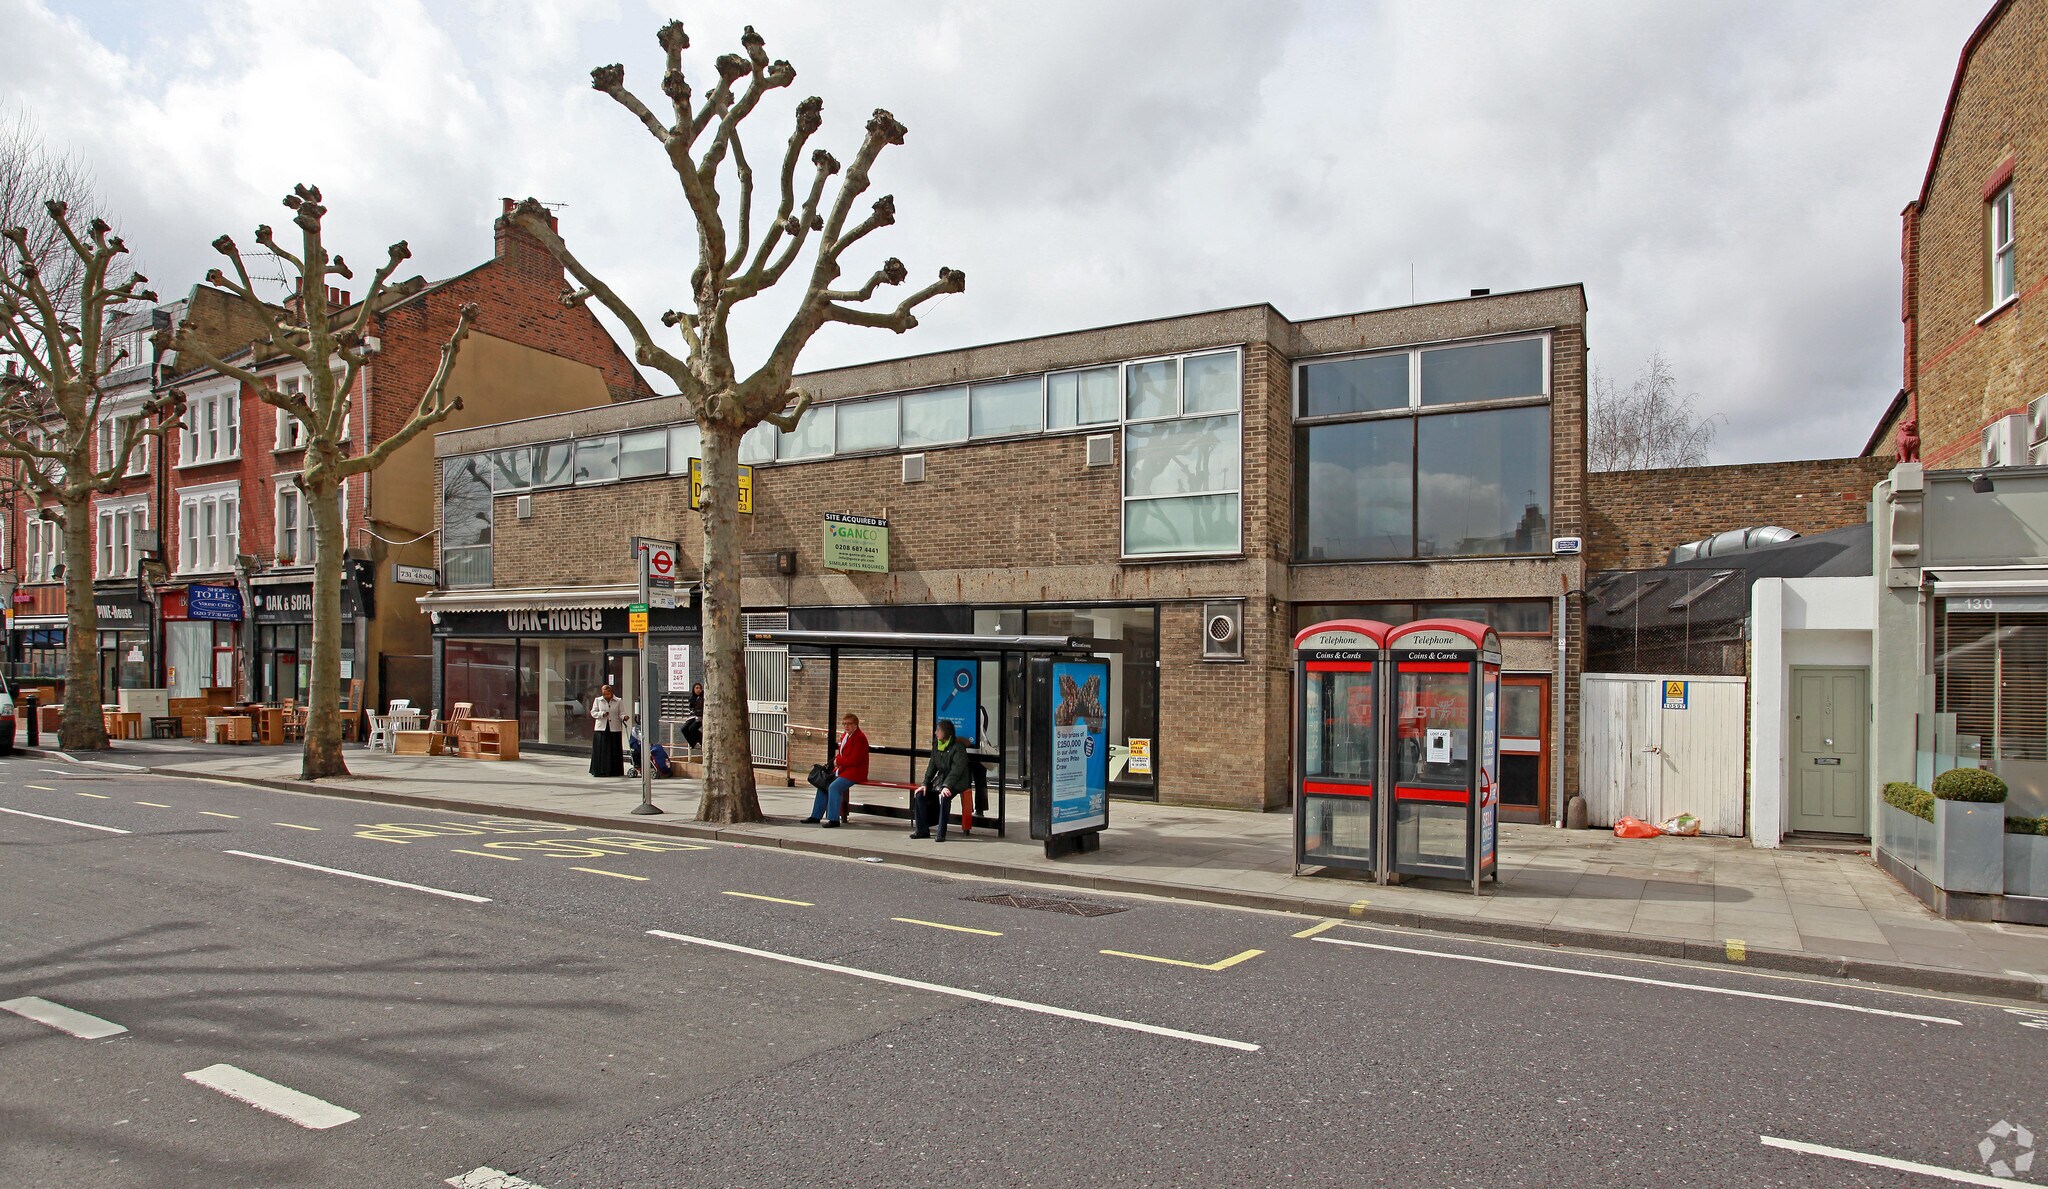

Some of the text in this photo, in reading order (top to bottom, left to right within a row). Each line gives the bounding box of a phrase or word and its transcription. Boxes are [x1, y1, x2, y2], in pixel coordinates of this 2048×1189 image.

[825, 513, 841, 521] SITE
[842, 515, 877, 525] ACQUIRED
[838, 527, 878, 541] GANCO
[400, 570, 433, 580] 731 4806
[195, 590, 238, 600] TO LET
[266, 594, 312, 611] OAK & SOFA
[1964, 598, 1993, 610] 130
[96, 605, 133, 619] PINE-House
[1319, 635, 1358, 646] Telephone
[1413, 635, 1454, 646] Telephone
[1315, 651, 1362, 659] Coins & Cards
[1408, 651, 1458, 660] Coins & Cards
[1056, 730, 1061, 739] 5
[1057, 739, 1082, 749] £250,000
[352, 820, 577, 844] STOP
[484, 837, 713, 859] BUS
